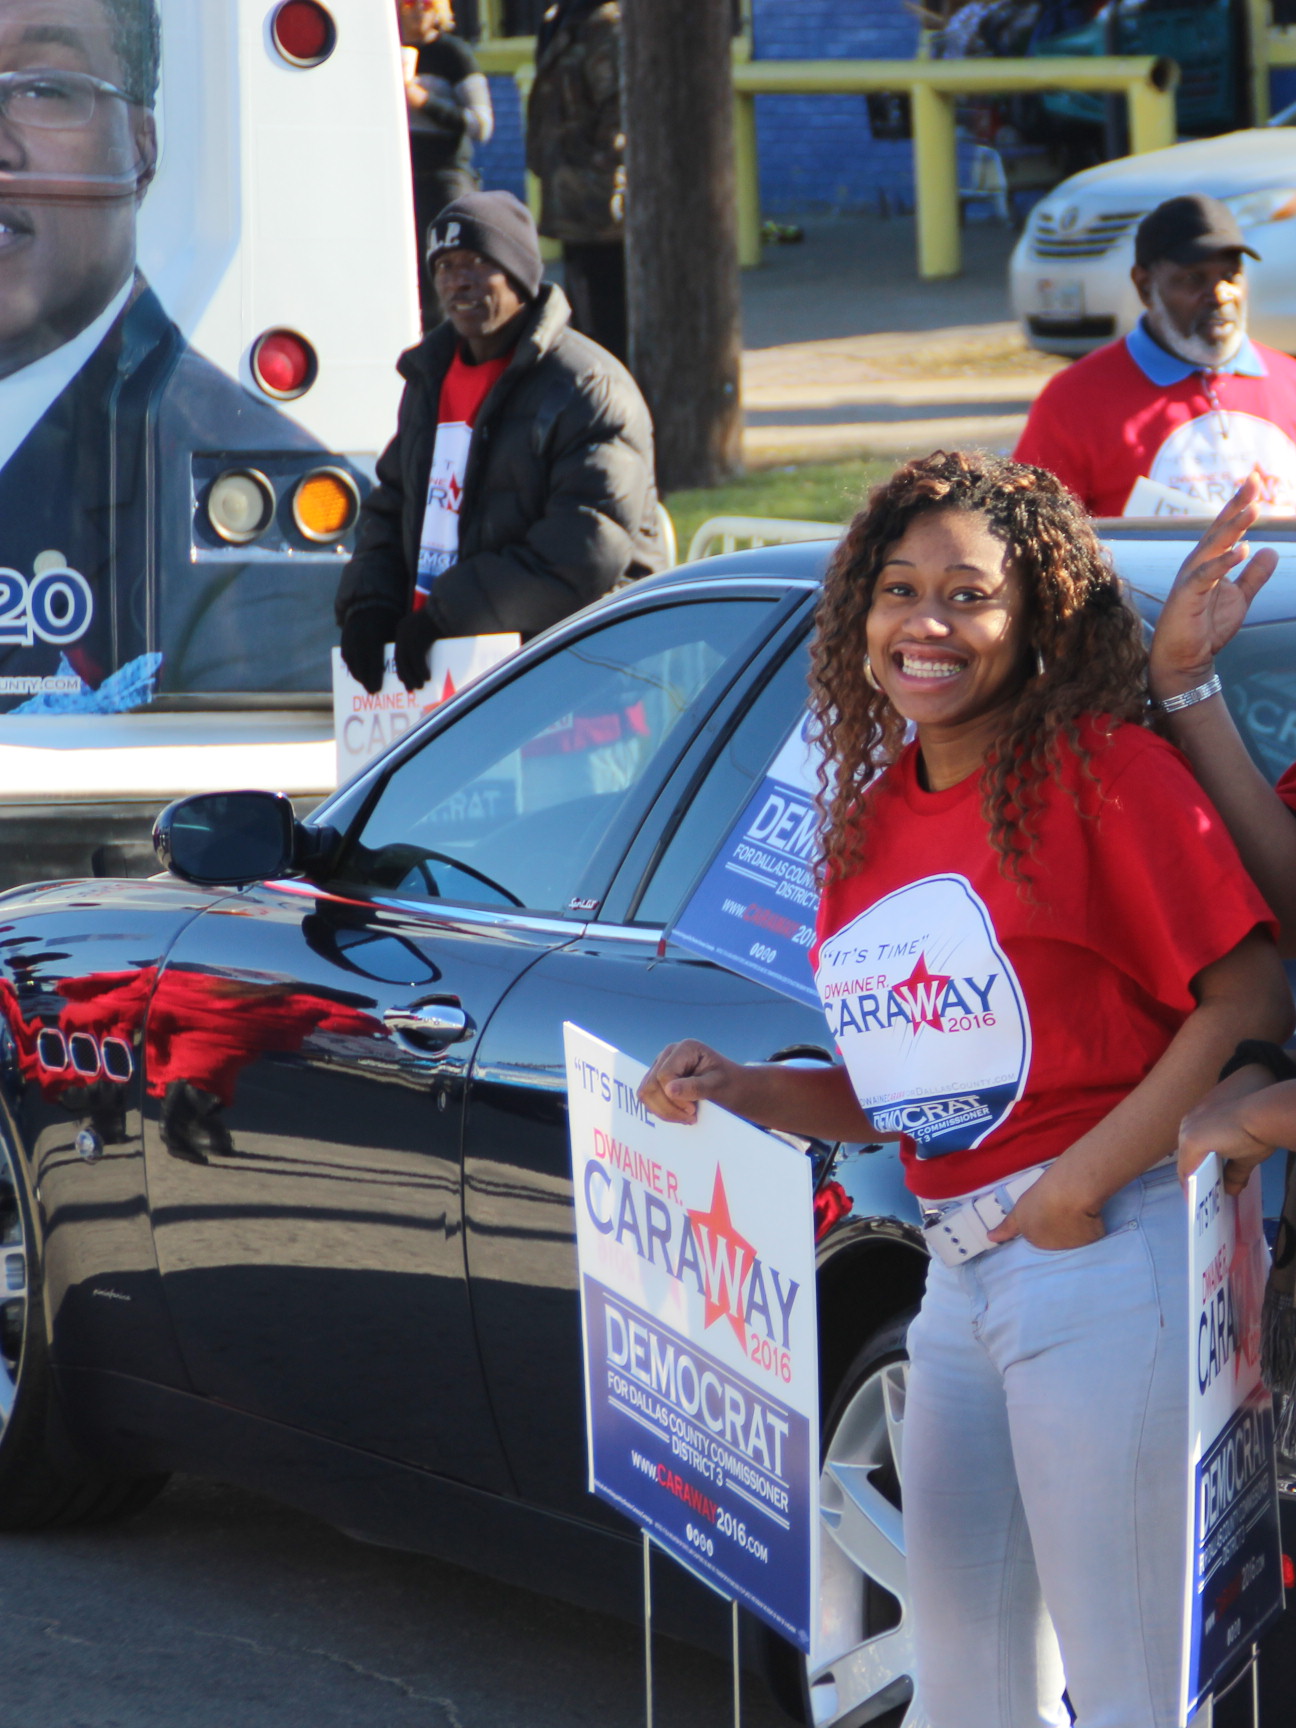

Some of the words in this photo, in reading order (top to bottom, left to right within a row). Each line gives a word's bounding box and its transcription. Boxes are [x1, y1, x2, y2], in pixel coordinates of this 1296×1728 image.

[353, 692, 403, 712] DWAINE
[733, 843, 755, 863] FOR
[751, 851, 789, 878] DALLAS
[823, 973, 999, 1038] CARAWAY
[824, 975, 875, 1000] DWAINE
[876, 974, 890, 989] R.
[948, 1012, 996, 1033] 2016
[873, 1096, 980, 1133] DEMOCRAT
[918, 1106, 991, 1138] COMMISSIONER
[593, 1128, 663, 1195] DWAINE
[666, 1170, 684, 1206] R.
[584, 1159, 800, 1351] CARAWAY
[751, 1333, 792, 1383] 2016
[604, 1303, 789, 1478] DEMOCRAT
[607, 1371, 629, 1400] FOR
[629, 1386, 668, 1427] DALLAS
[669, 1413, 710, 1456] COUNTY
[710, 1443, 789, 1513] COMMISSIONER
[671, 1435, 716, 1481] DISTRICT
[716, 1467, 724, 1486] 3
